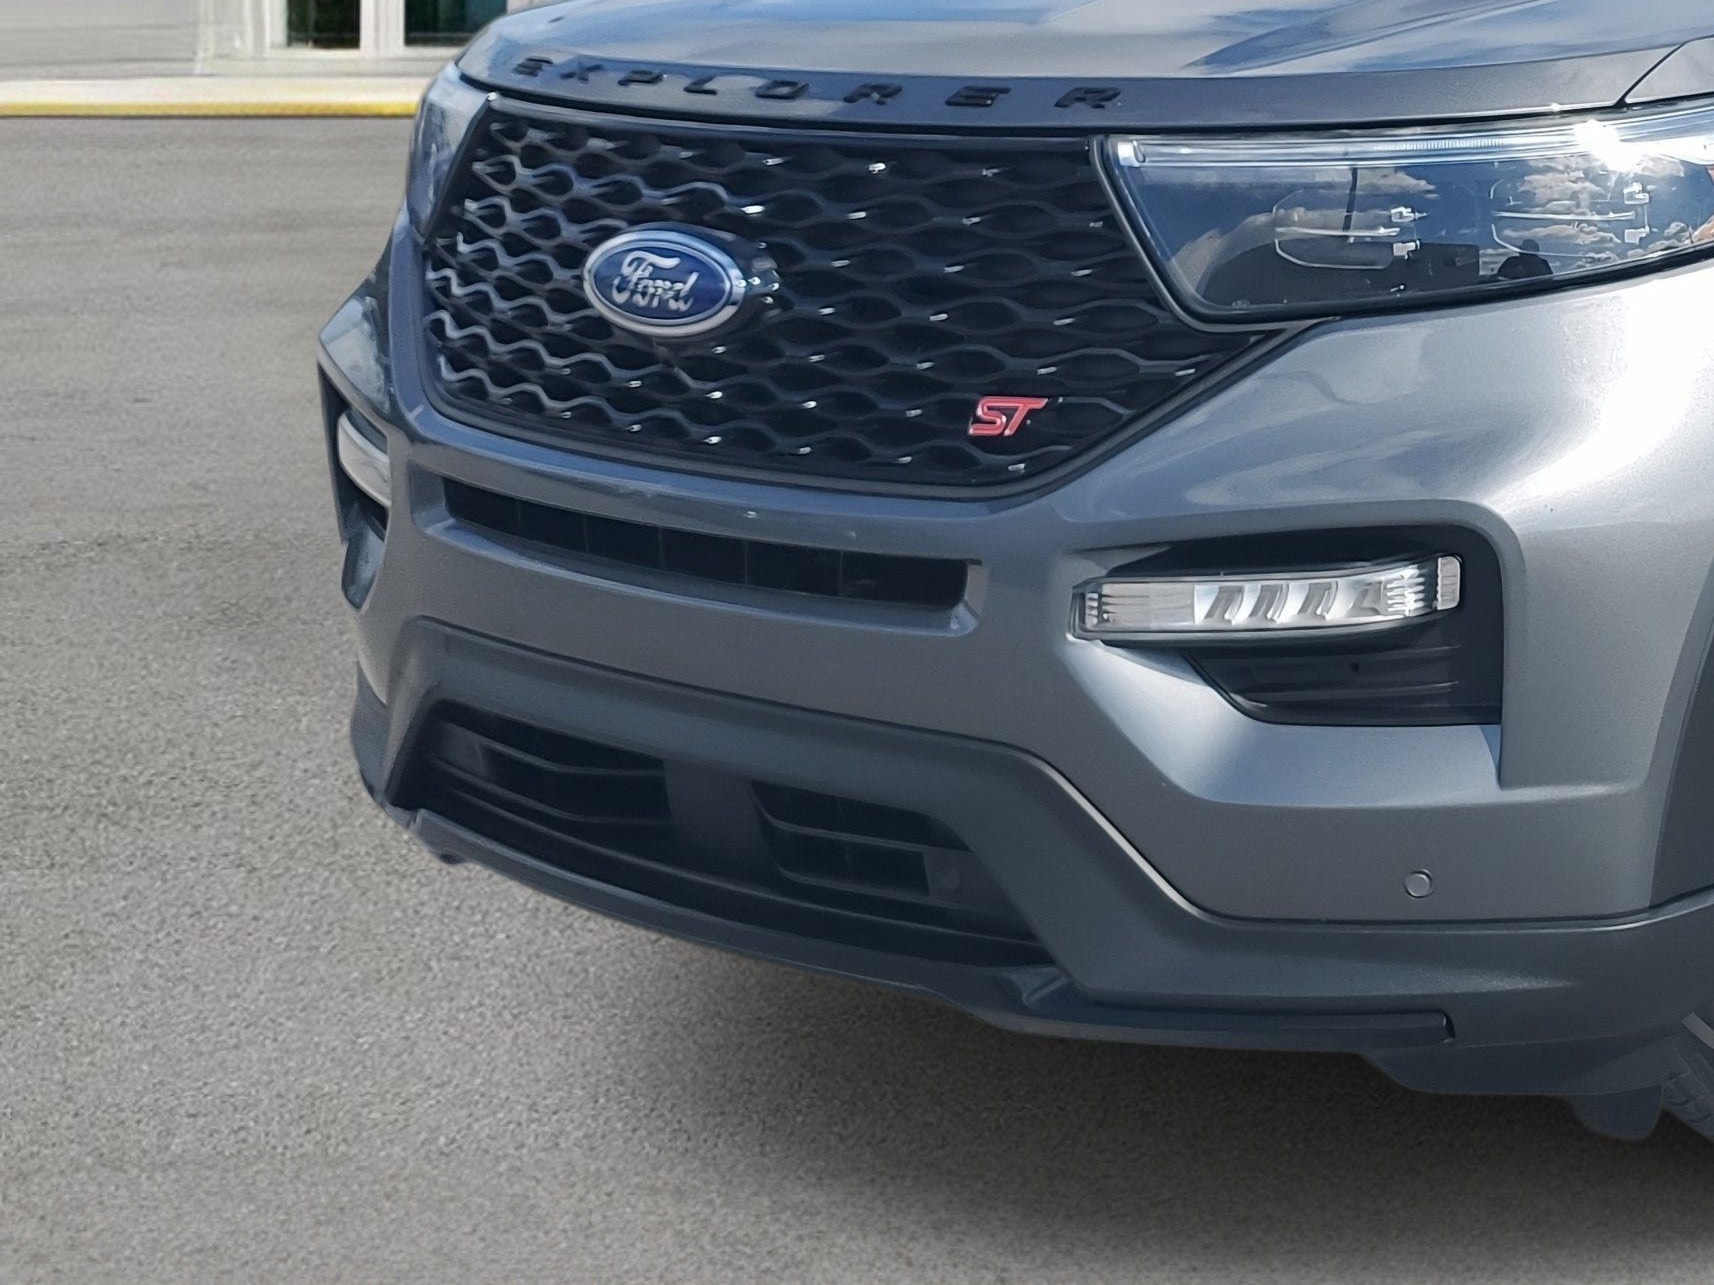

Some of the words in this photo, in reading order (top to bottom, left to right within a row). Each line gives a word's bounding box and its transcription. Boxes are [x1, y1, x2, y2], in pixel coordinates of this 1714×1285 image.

[513, 56, 1121, 110] EXPLORER
[612, 250, 700, 312] Ford
[968, 395, 1049, 437] ST
